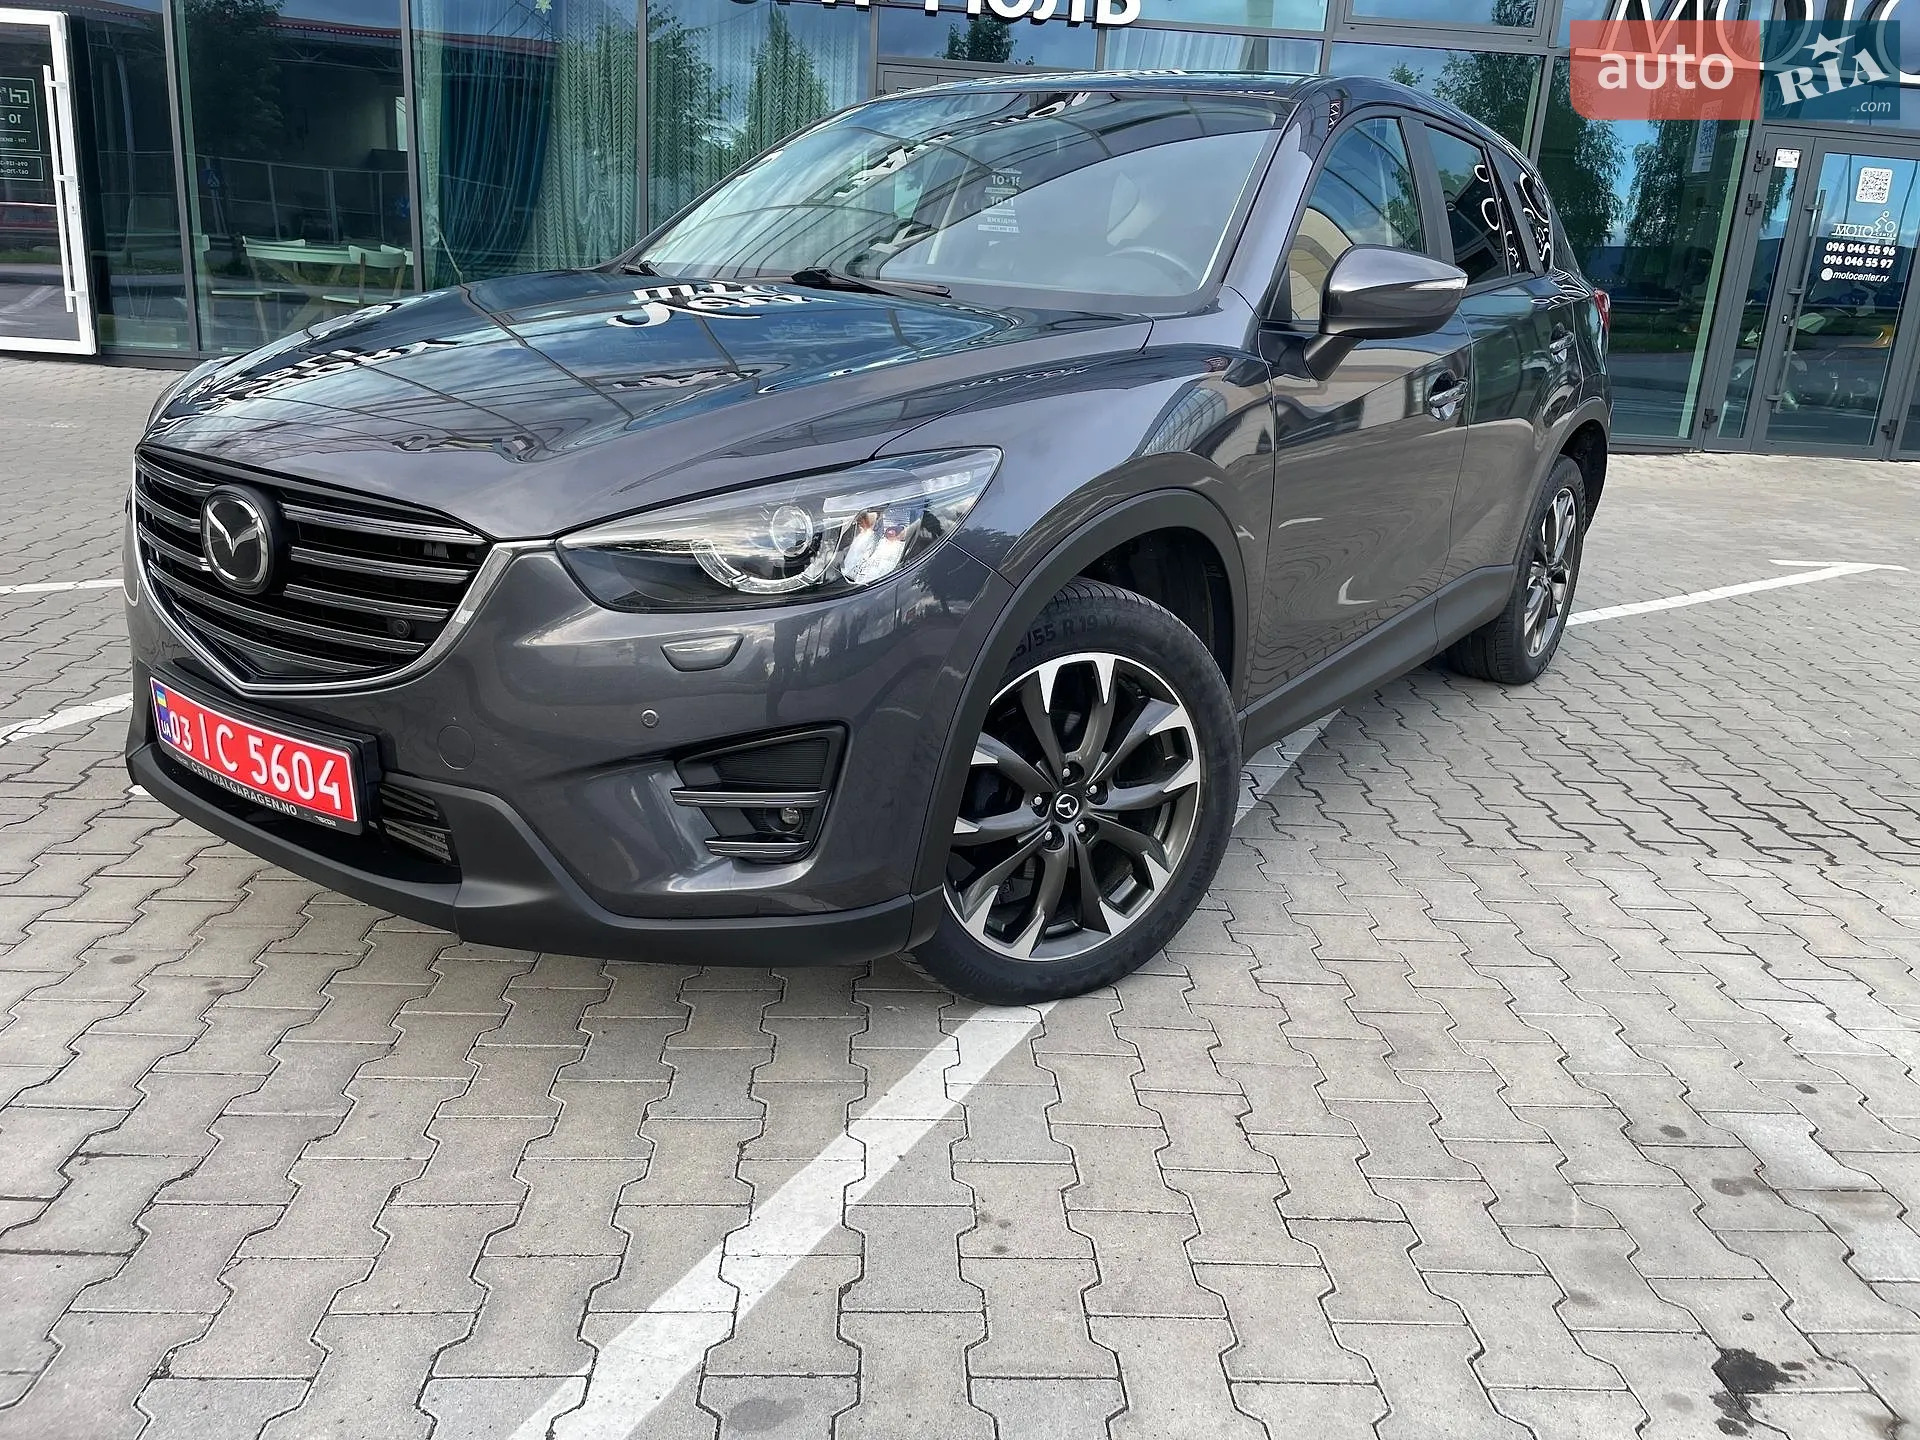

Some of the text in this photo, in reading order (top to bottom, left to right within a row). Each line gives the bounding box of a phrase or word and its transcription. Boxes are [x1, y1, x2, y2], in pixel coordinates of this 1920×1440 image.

[1826, 241, 1896, 256] 096 046 55 96
[1823, 254, 1894, 269] 096 046 55 97
[1832, 270, 1890, 283] motocenter.rv
[160, 719, 172, 738] UA
[169, 710, 194, 751] 03
[247, 734, 342, 810] 5604
[191, 761, 298, 817] CENTRALGARAGEN.NO
